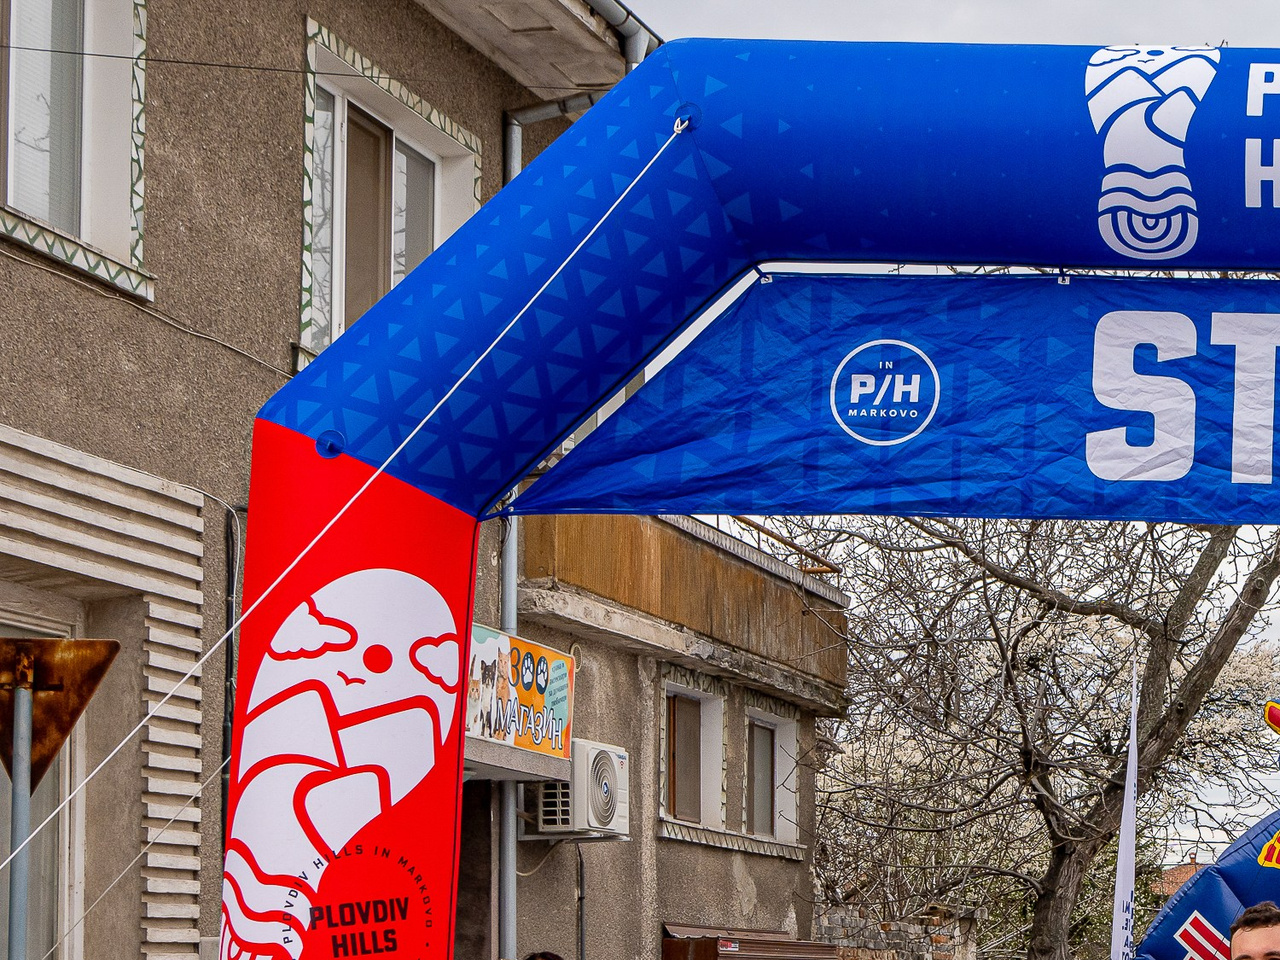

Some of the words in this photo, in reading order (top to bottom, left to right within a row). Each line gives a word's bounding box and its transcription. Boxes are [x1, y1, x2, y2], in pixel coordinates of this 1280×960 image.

[879, 361, 893, 369] IN
[850, 374, 920, 405] P/H
[848, 409, 918, 418] MARKOVO
[496, 697, 563, 750] МАГАЗИН
[282, 871, 309, 944] PLOVDIV
[313, 845, 363, 869] HILLS
[374, 846, 391, 858] IN
[398, 856, 433, 928] MARKOVO
[309, 897, 409, 931] PLOVDIV
[331, 929, 398, 958] HILLS
